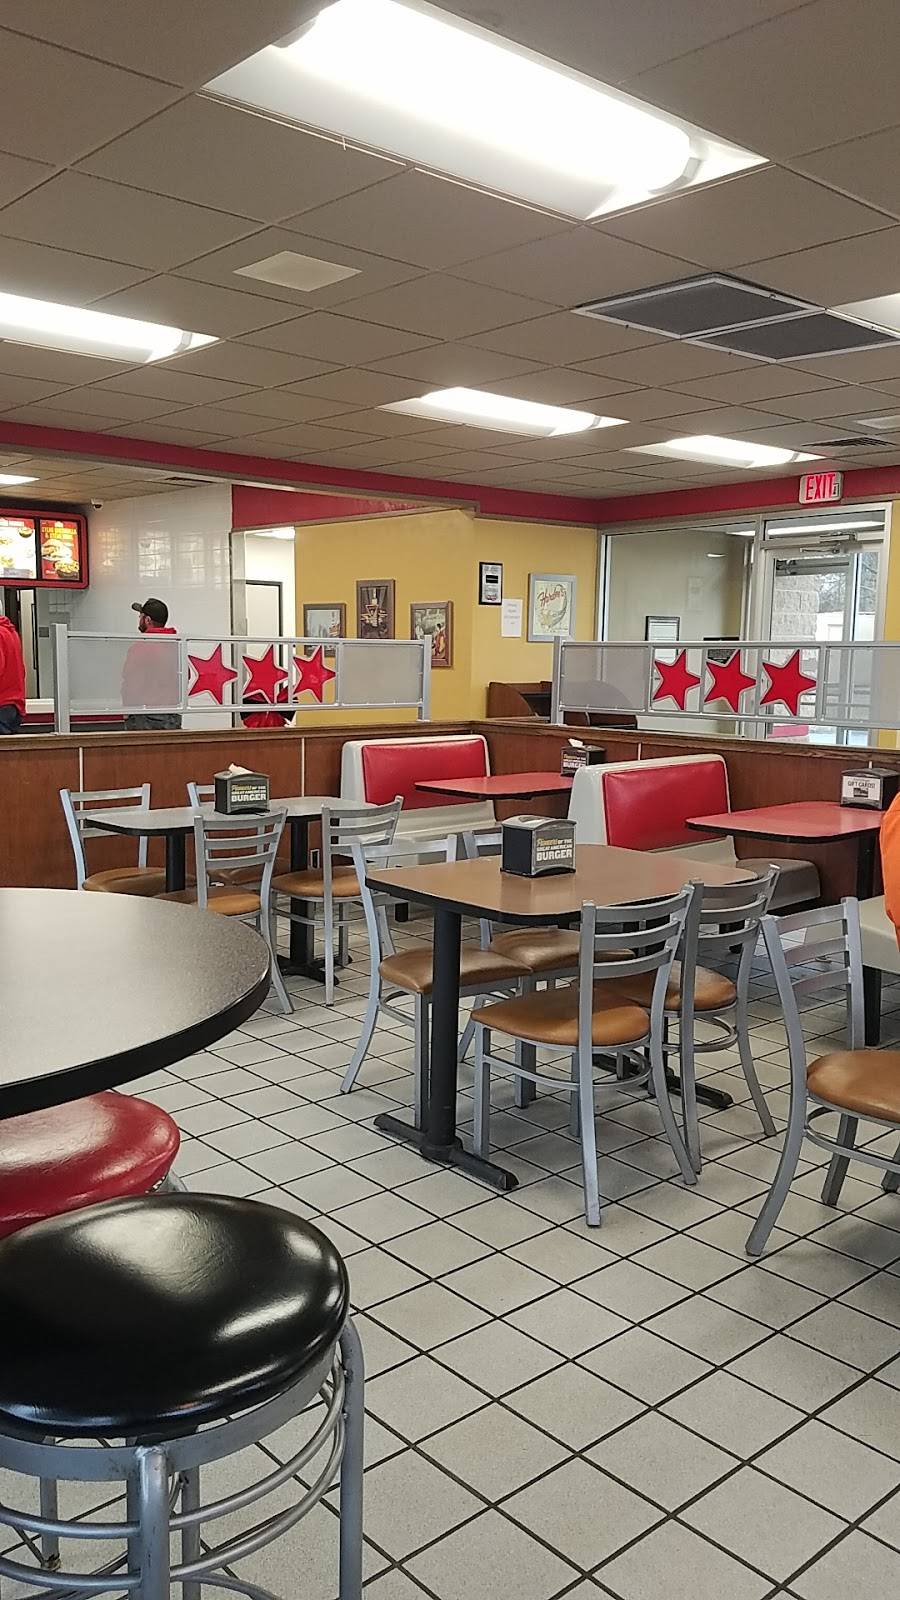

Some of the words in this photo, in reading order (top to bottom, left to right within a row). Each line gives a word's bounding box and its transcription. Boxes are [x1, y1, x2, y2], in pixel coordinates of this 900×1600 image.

[806, 474, 836, 500] EXIT
[231, 793, 267, 802] BURGER
[536, 849, 573, 861] BURGER
